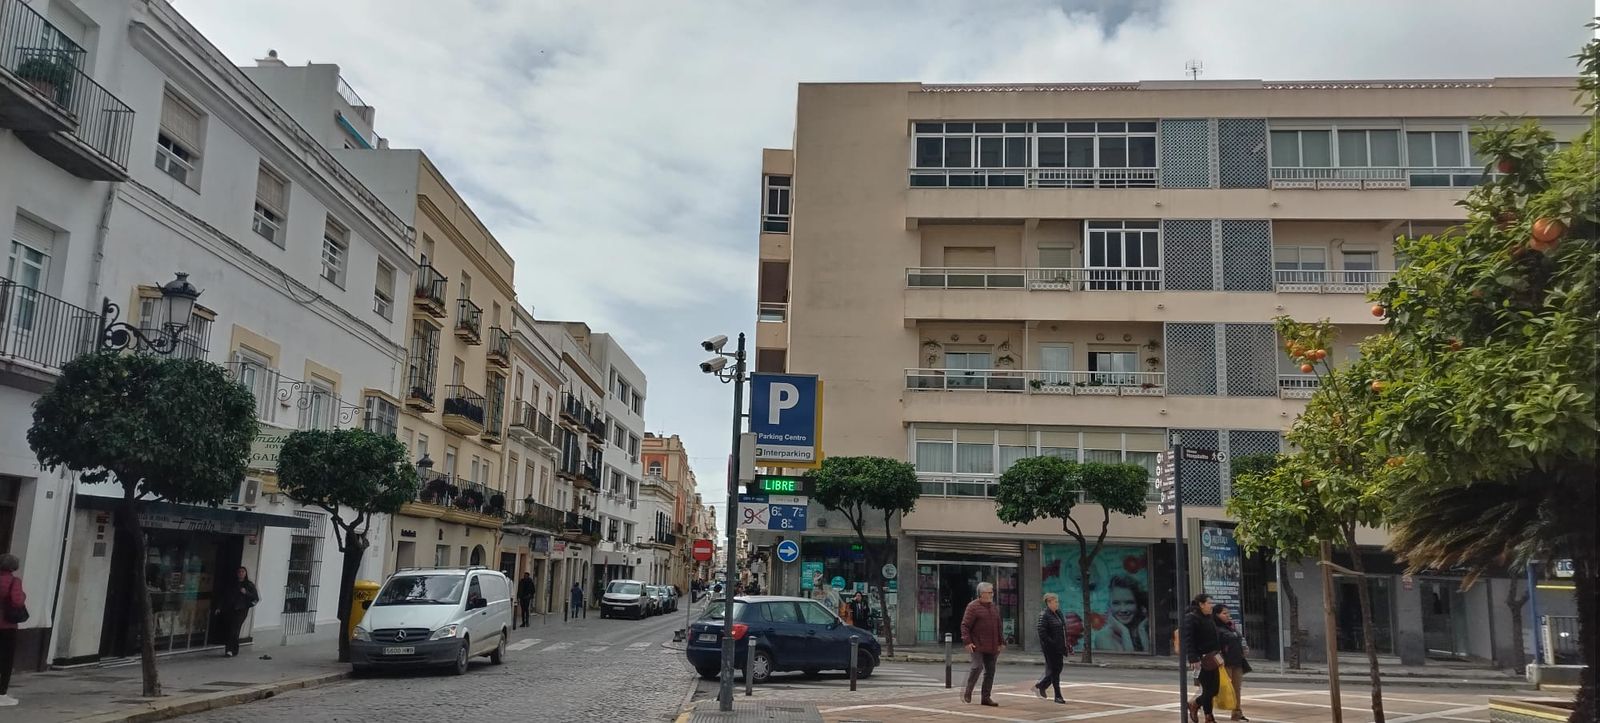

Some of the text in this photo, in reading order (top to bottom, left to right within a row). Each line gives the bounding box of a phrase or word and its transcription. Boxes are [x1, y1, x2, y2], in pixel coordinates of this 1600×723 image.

[769, 382, 800, 425] P
[758, 433, 783, 441] Parking
[763, 449, 811, 459] Interparking
[765, 480, 795, 491] LIBRE
